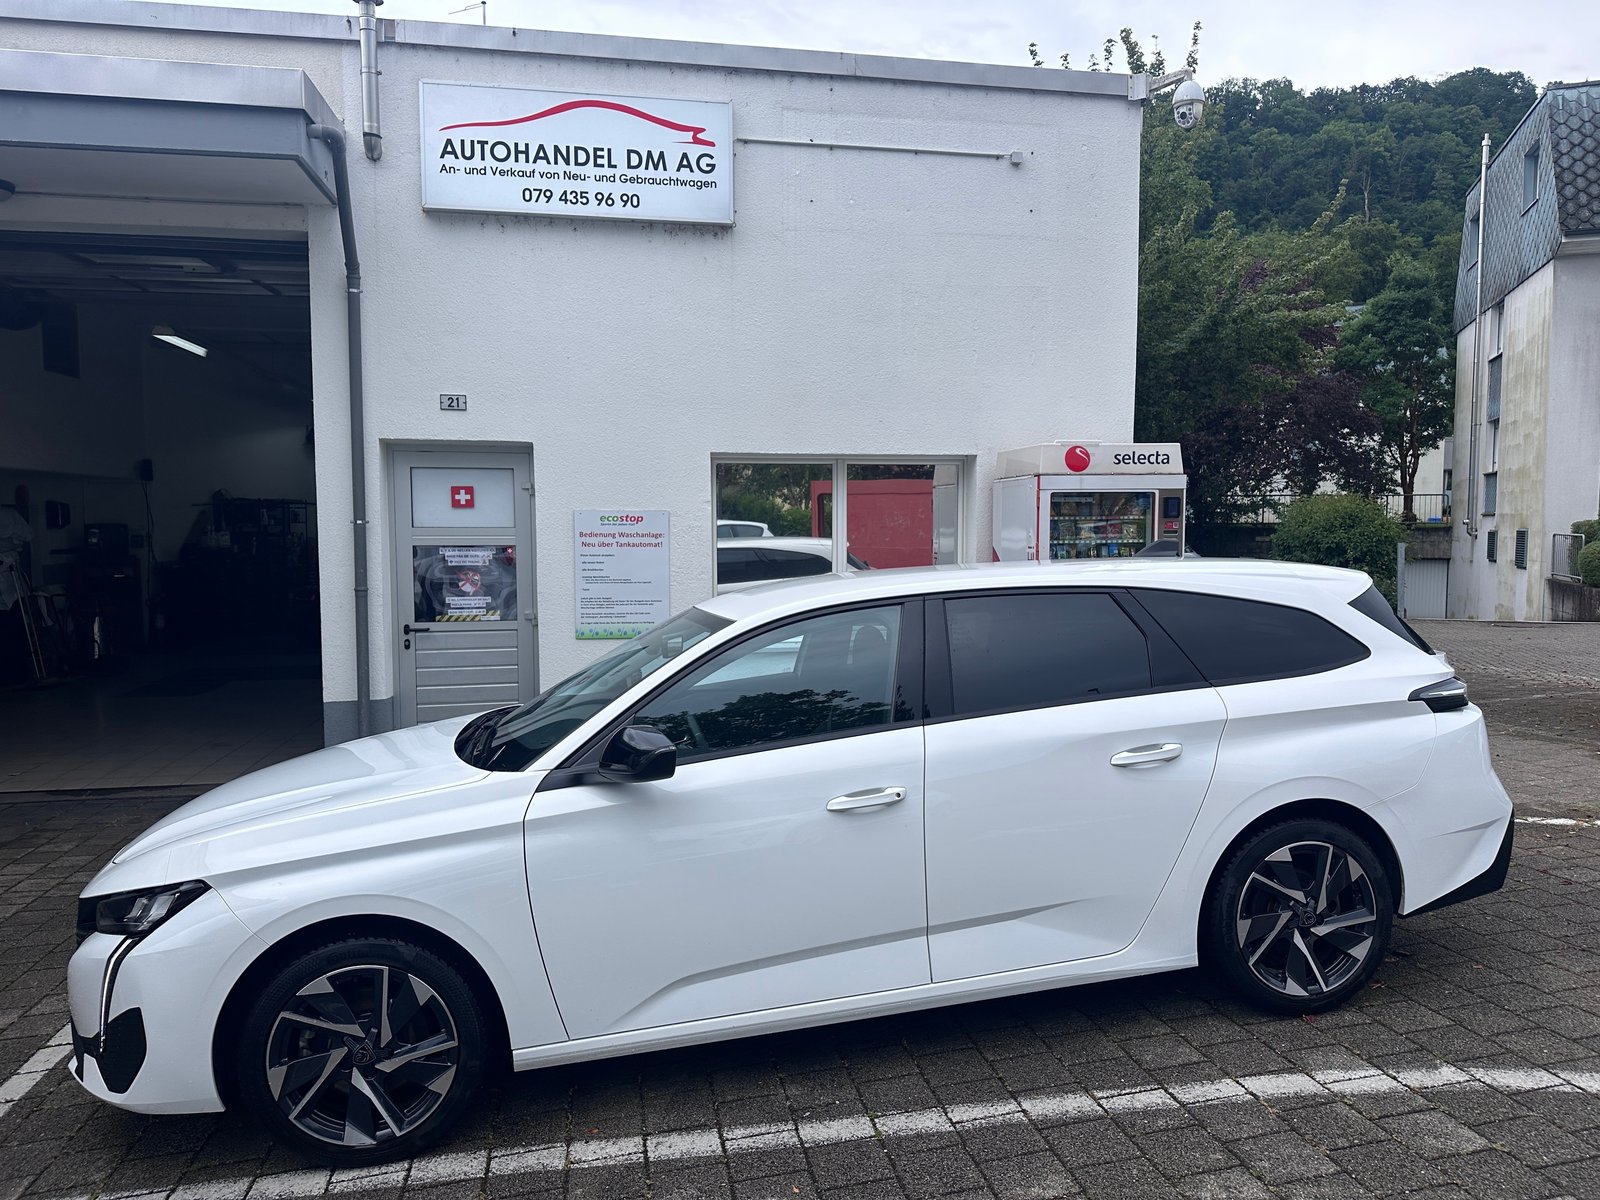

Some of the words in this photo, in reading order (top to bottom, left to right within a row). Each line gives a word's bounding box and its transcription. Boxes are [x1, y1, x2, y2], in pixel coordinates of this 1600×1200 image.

[440, 138, 618, 169] AUTOHANDEL
[626, 149, 668, 171] DM
[676, 152, 716, 174] AG
[440, 164, 461, 174] An-
[464, 166, 487, 175] und
[490, 166, 536, 178] Verkauf
[538, 171, 560, 180] von
[563, 171, 591, 181] Neu-
[594, 174, 616, 183] und
[619, 173, 717, 190] Gebrauchtwagen
[522, 188, 553, 203] 079
[558, 190, 590, 205] 435
[594, 192, 615, 207] 96
[620, 193, 640, 208] 90
[447, 396, 460, 408] 21
[1113, 451, 1170, 465] selecta
[600, 514, 644, 524] ecostop
